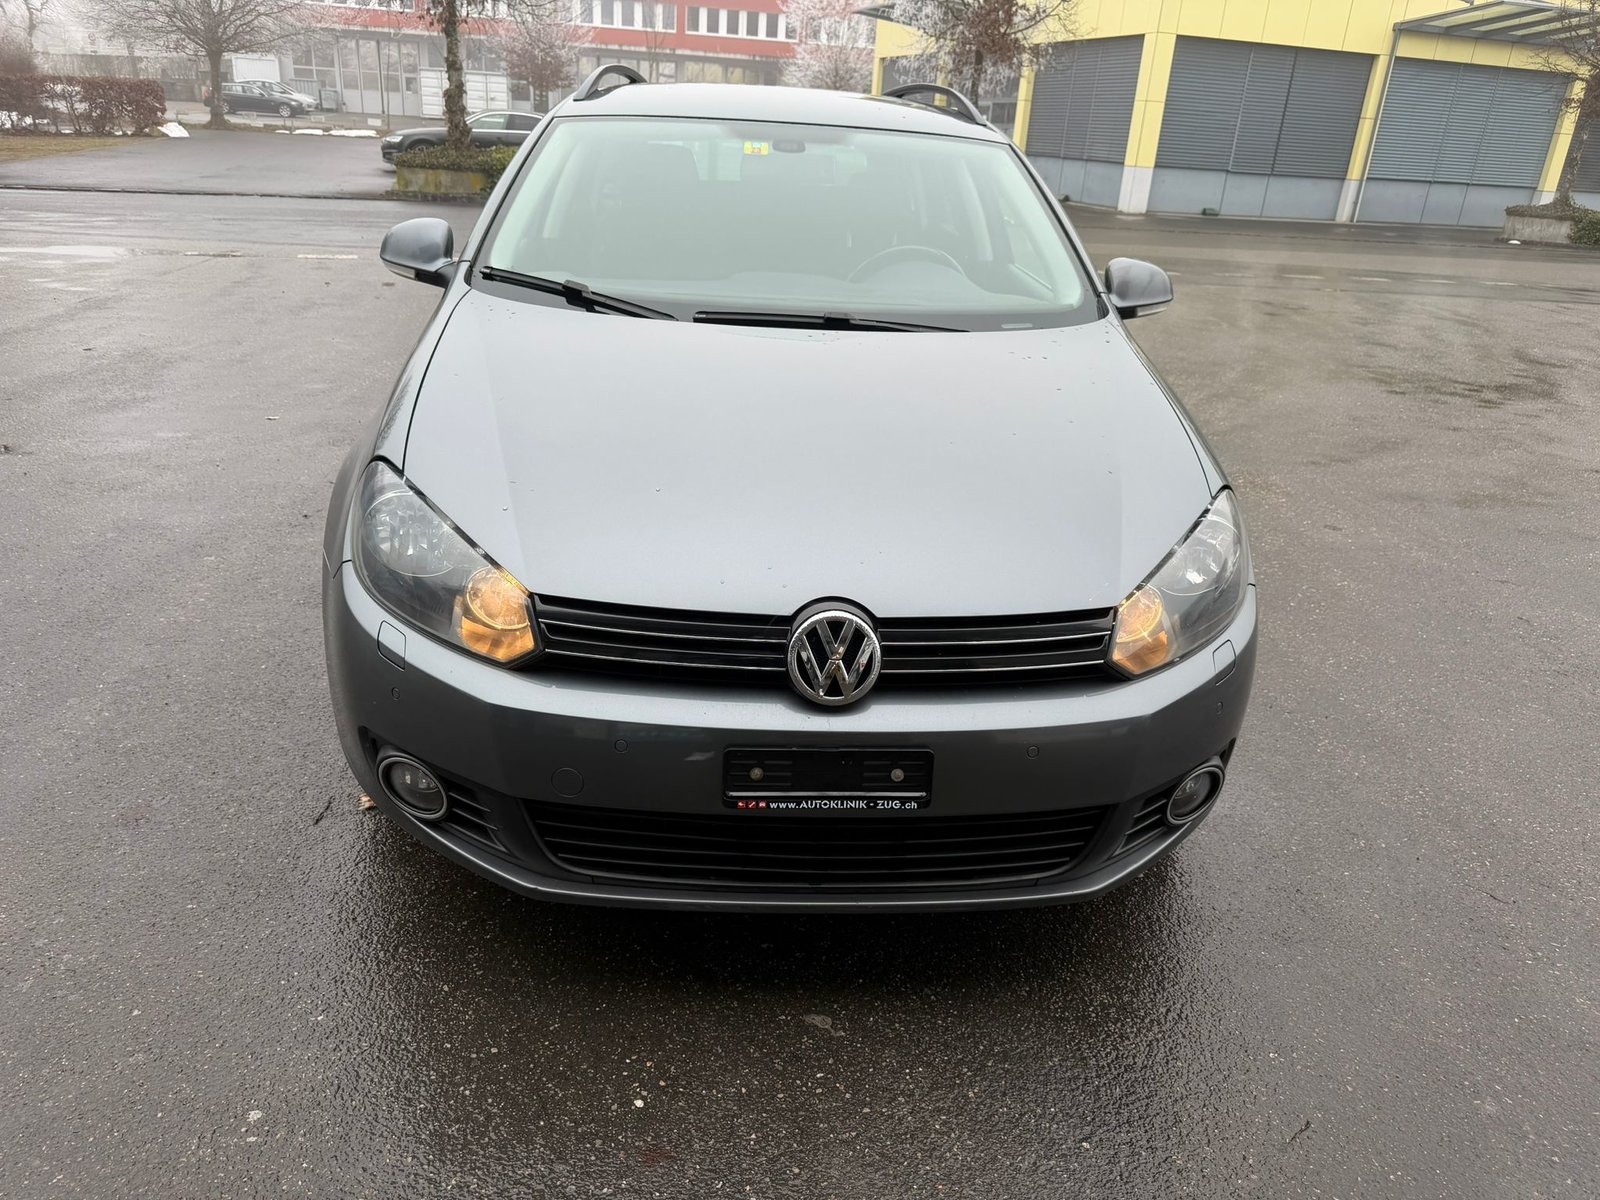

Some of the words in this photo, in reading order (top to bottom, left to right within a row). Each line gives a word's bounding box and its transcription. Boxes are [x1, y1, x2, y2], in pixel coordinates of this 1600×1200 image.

[795, 617, 876, 699] VW
[769, 800, 867, 809] www.AUTOKLINIK
[876, 800, 918, 809] ZUG.ch
